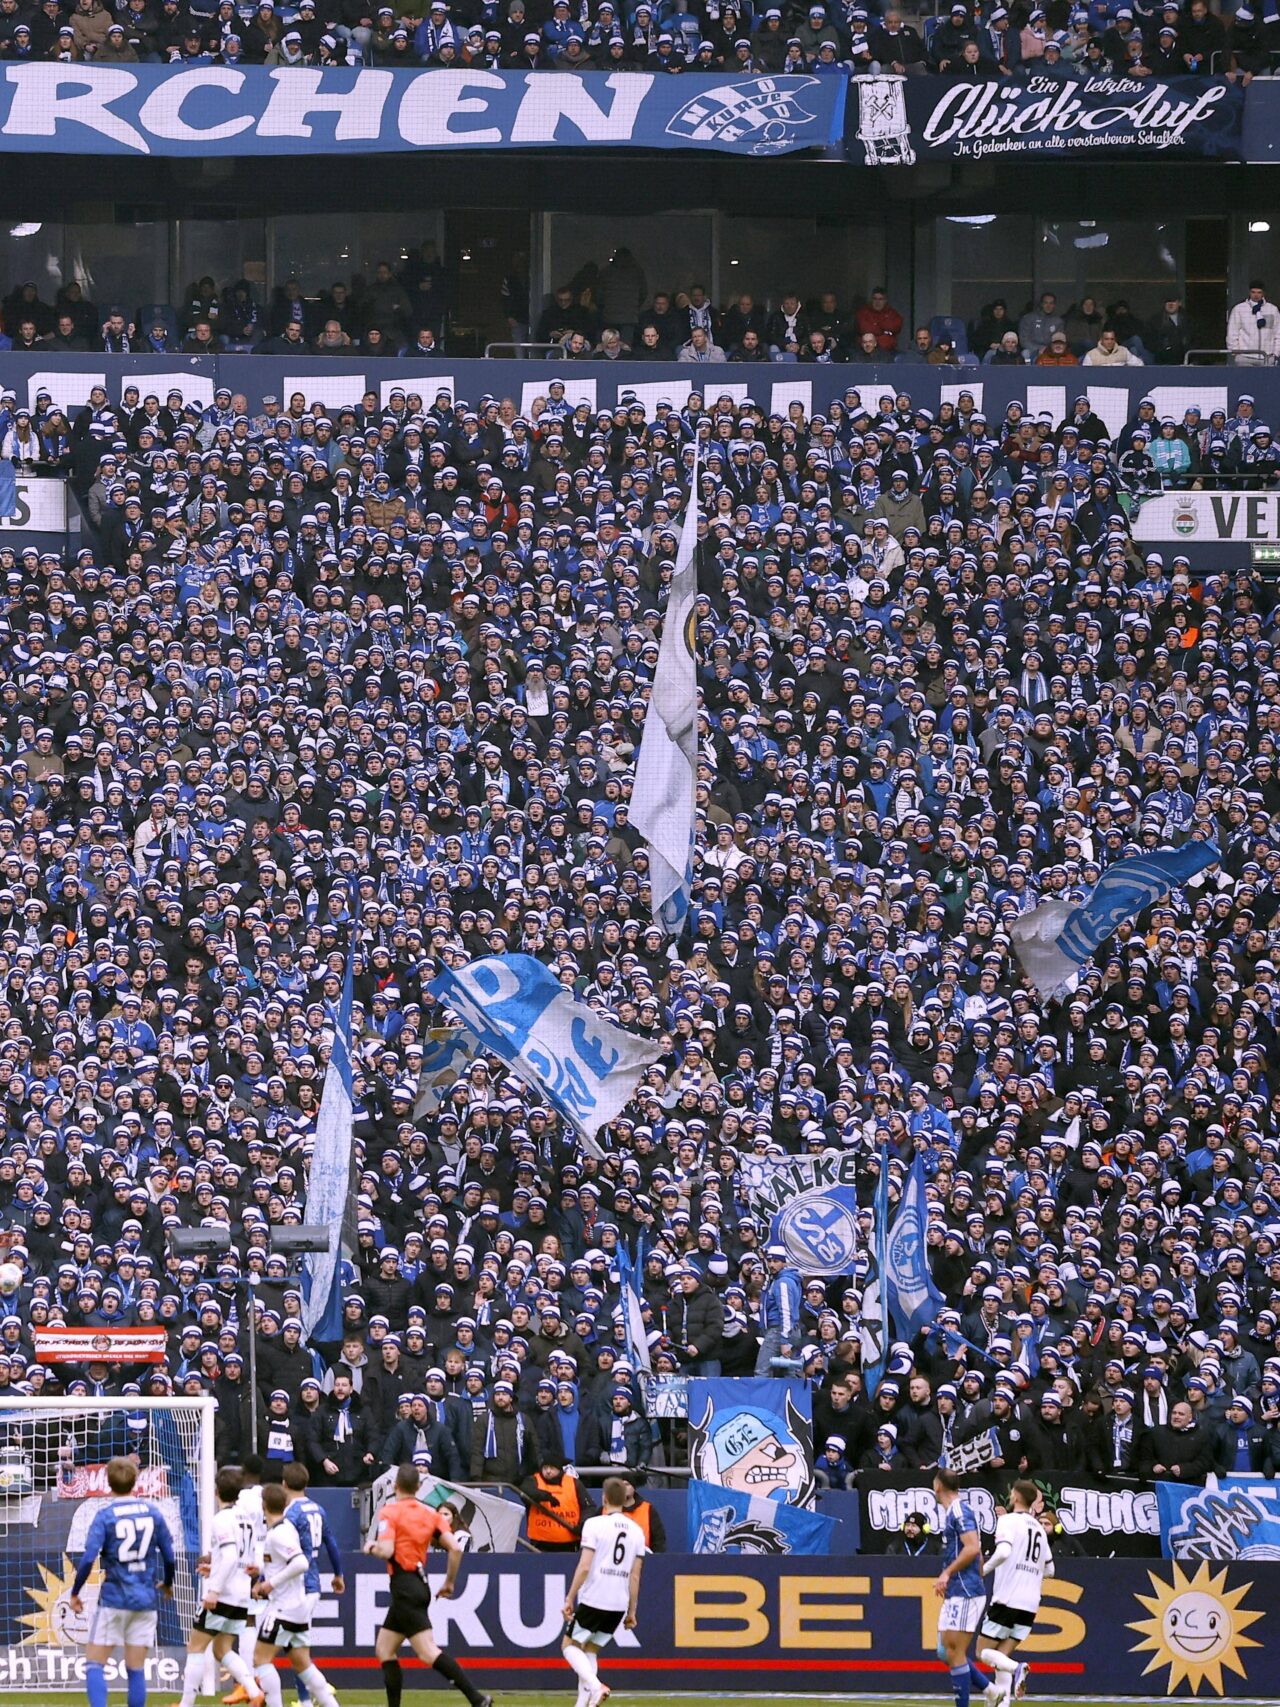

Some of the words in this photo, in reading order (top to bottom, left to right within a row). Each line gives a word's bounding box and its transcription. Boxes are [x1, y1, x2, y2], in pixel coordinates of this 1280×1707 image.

[1027, 76, 1058, 94] Ein
[1084, 76, 1145, 95] letztes
[923, 81, 1083, 148] Glück
[1080, 83, 1227, 149] Auf
[953, 141, 971, 157] In
[973, 138, 1026, 159] Gedenken
[1028, 139, 1043, 149] an
[1044, 134, 1067, 149] alle
[1067, 132, 1137, 147] verstorbenen
[1137, 130, 1186, 146] Schalker
[1210, 496, 1280, 539] VE
[116, 1516, 155, 1562] 27
[613, 1531, 627, 1565] 6
[1025, 1528, 1042, 1563] 16
